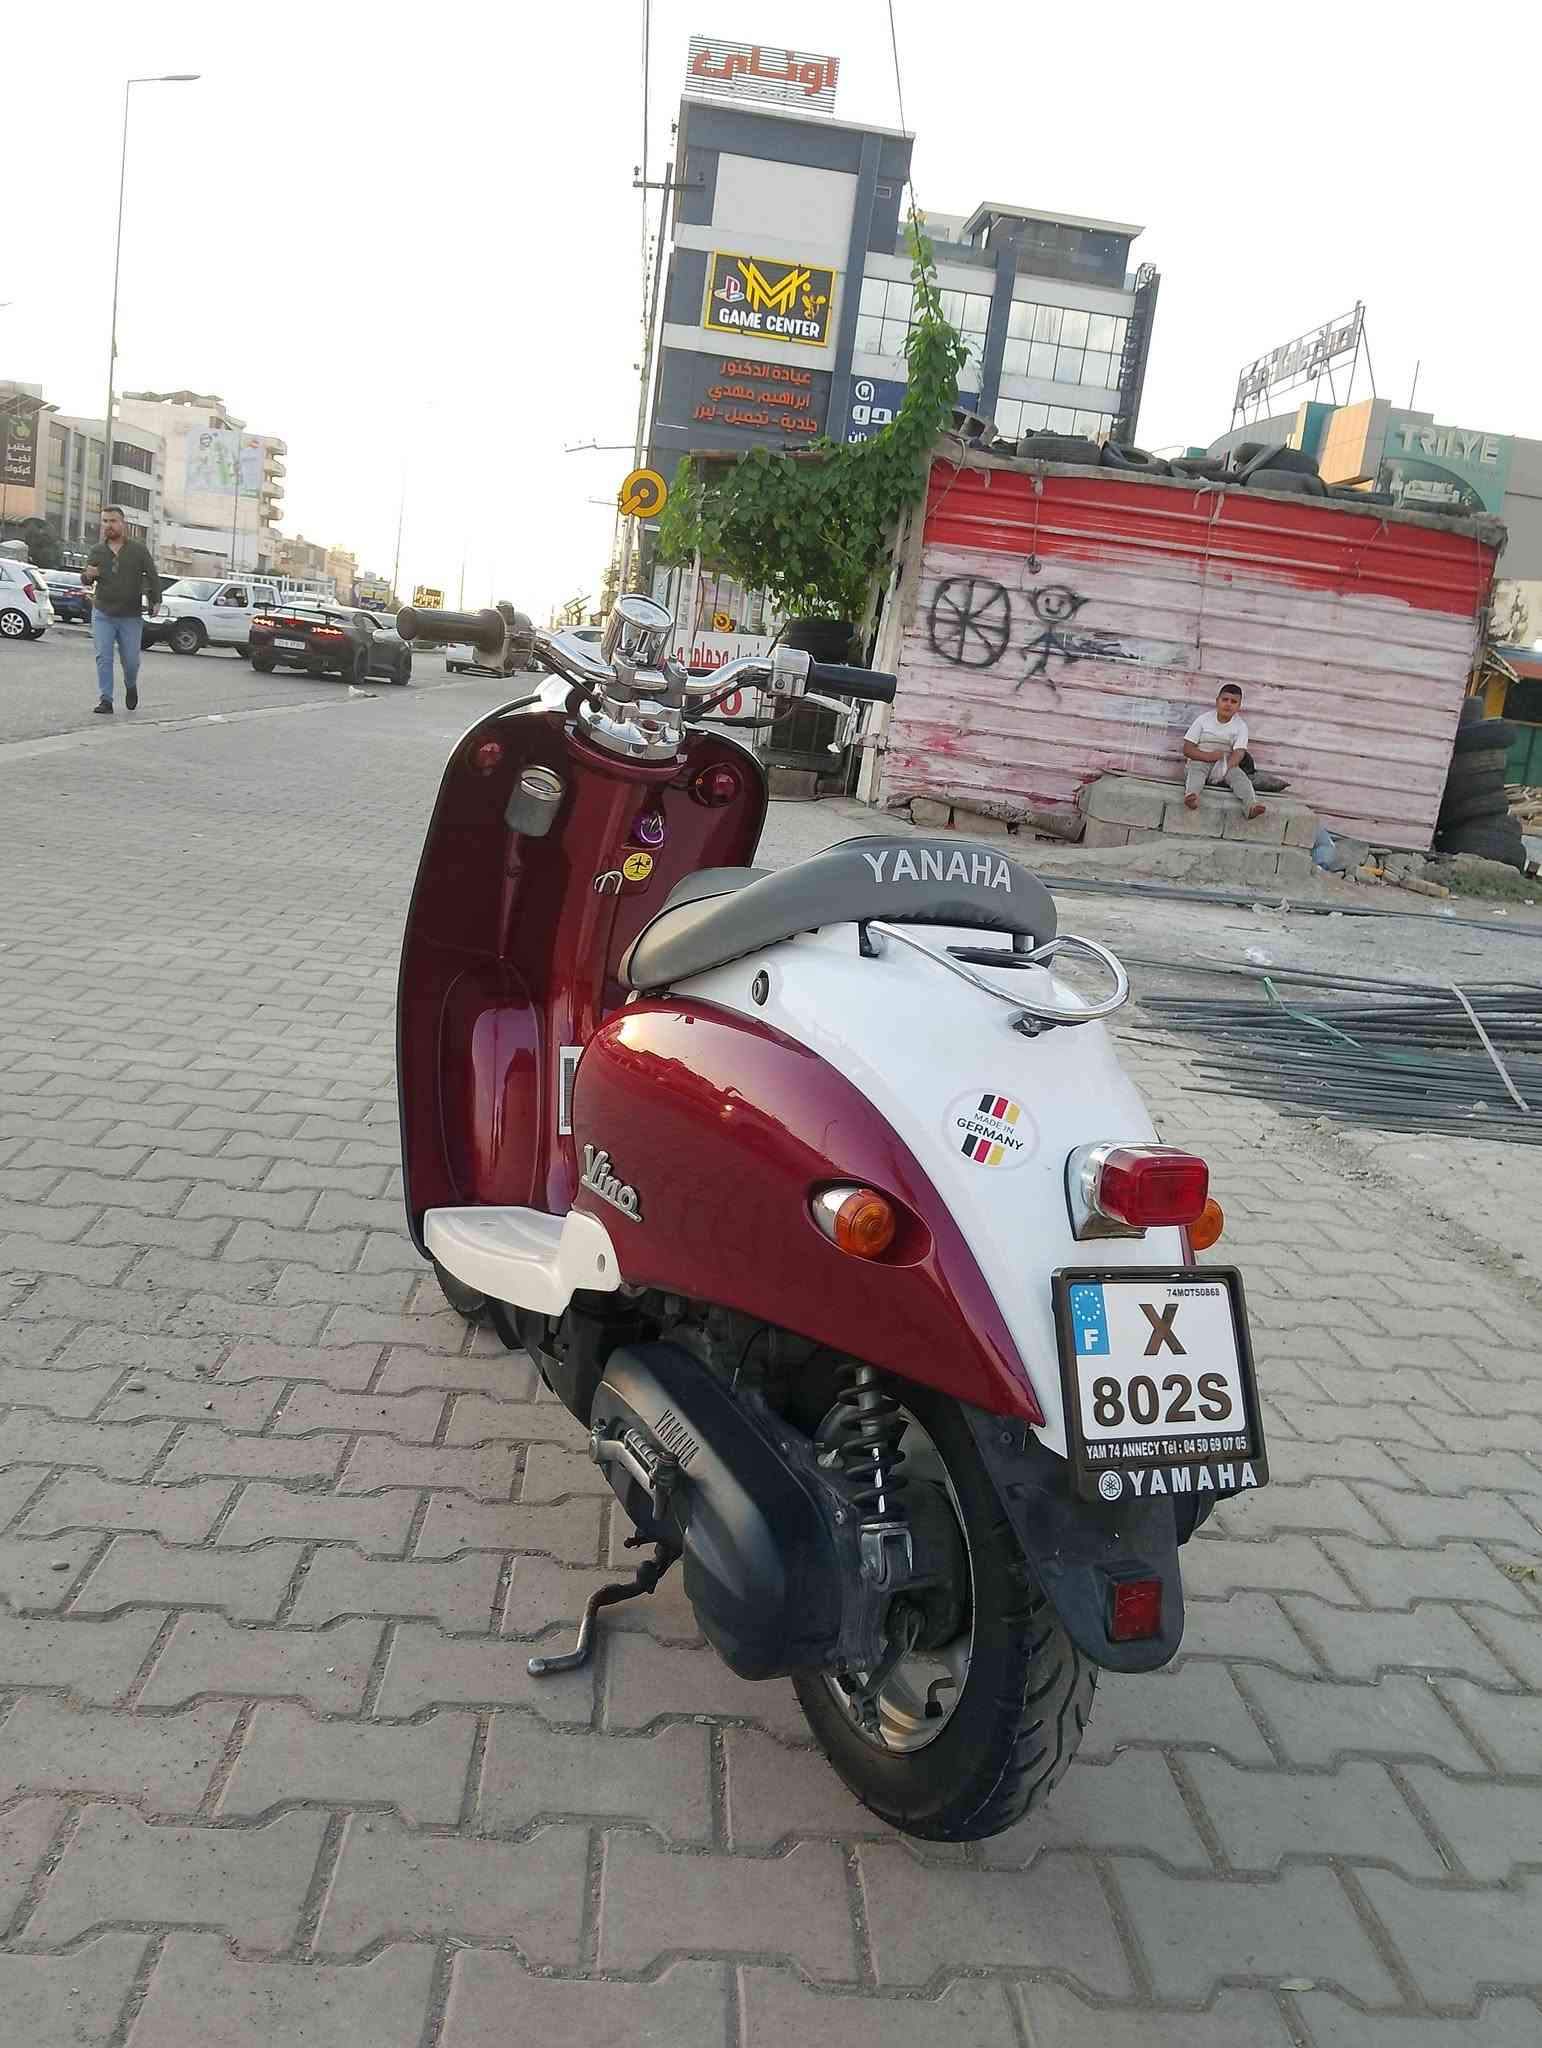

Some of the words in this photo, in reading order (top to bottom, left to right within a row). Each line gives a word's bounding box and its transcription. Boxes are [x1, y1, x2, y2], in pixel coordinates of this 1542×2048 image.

[719, 307, 762, 330] GAME
[766, 315, 820, 338] CENTER
[720, 359, 769, 377] الدكتور
[771, 366, 811, 385] عيادة
[862, 849, 1012, 893] YANAHA
[956, 1117, 1024, 1151] GERMANY
[974, 1113, 1003, 1130] MADE
[1003, 1126, 1015, 1135] IN
[583, 1143, 640, 1216] Vino
[1083, 1328, 1099, 1350] F
[1138, 1303, 1187, 1356] X
[1092, 1372, 1233, 1427] 802S
[1086, 1444, 1107, 1459] YAM
[1108, 1444, 1121, 1459] 74
[1122, 1441, 1160, 1457] ANNECY
[1161, 1440, 1177, 1455] Tél
[1184, 1439, 1195, 1453] 04
[1197, 1438, 1208, 1452] 50
[1210, 1437, 1221, 1451] 69
[1222, 1437, 1233, 1450] 07
[1235, 1436, 1247, 1450] 05
[1127, 1462, 1258, 1496] YAMAHA
